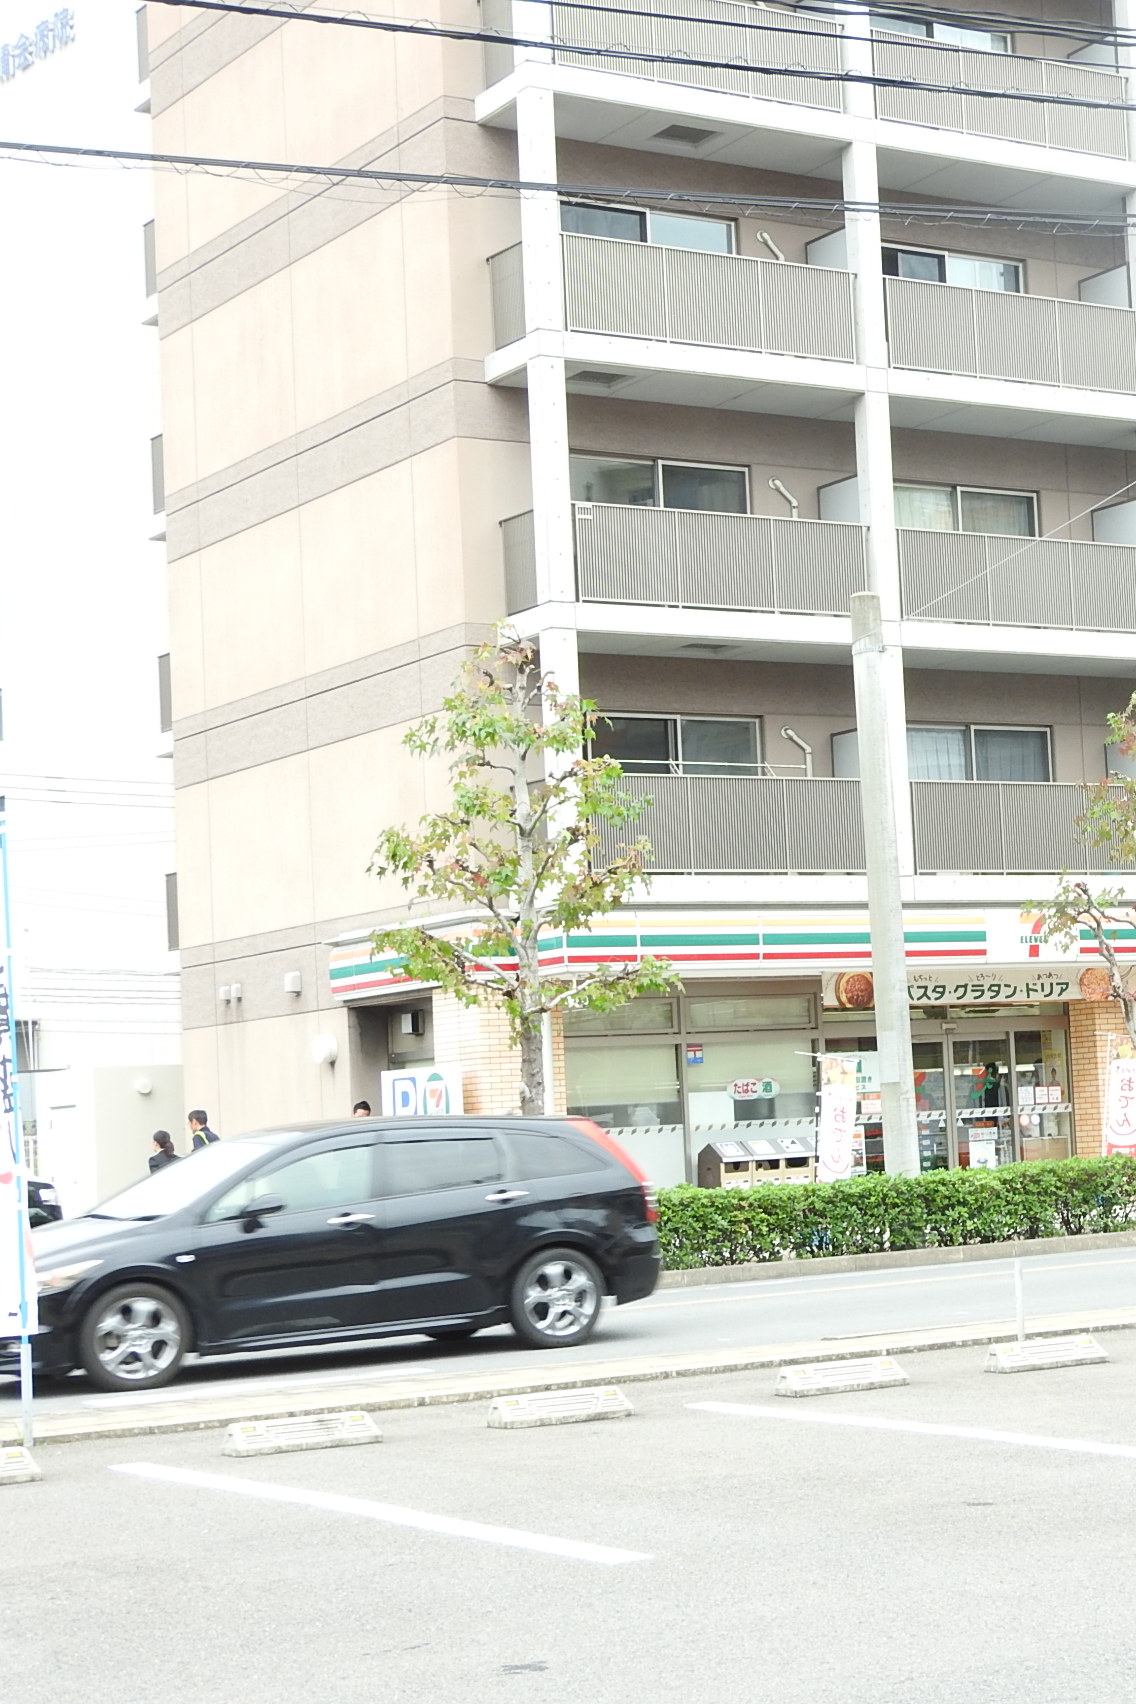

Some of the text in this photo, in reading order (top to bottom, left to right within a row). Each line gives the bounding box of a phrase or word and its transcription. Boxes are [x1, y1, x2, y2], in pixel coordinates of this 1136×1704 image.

[733, 1081, 773, 1095] たばこ 酒
